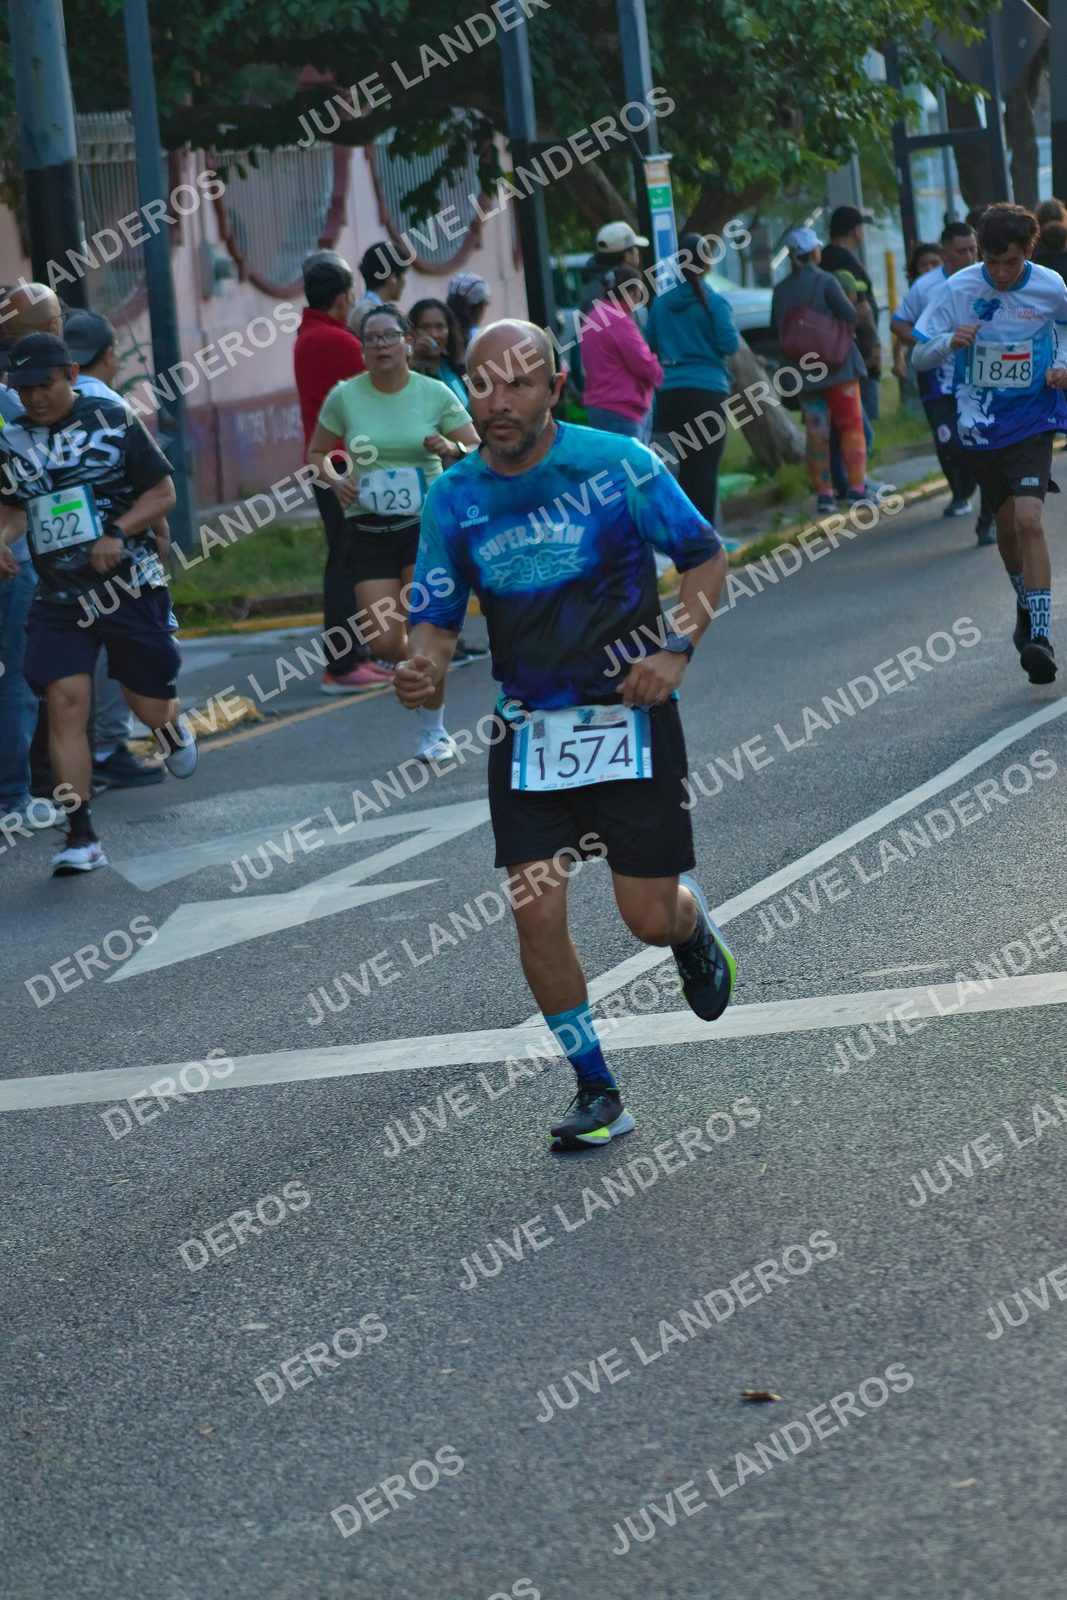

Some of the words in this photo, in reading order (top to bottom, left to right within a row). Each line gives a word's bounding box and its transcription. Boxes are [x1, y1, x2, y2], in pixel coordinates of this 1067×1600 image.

[977, 360, 1032, 382] 1848
[370, 488, 412, 511] 123
[41, 512, 84, 545] 522
[534, 733, 633, 781] 1574
